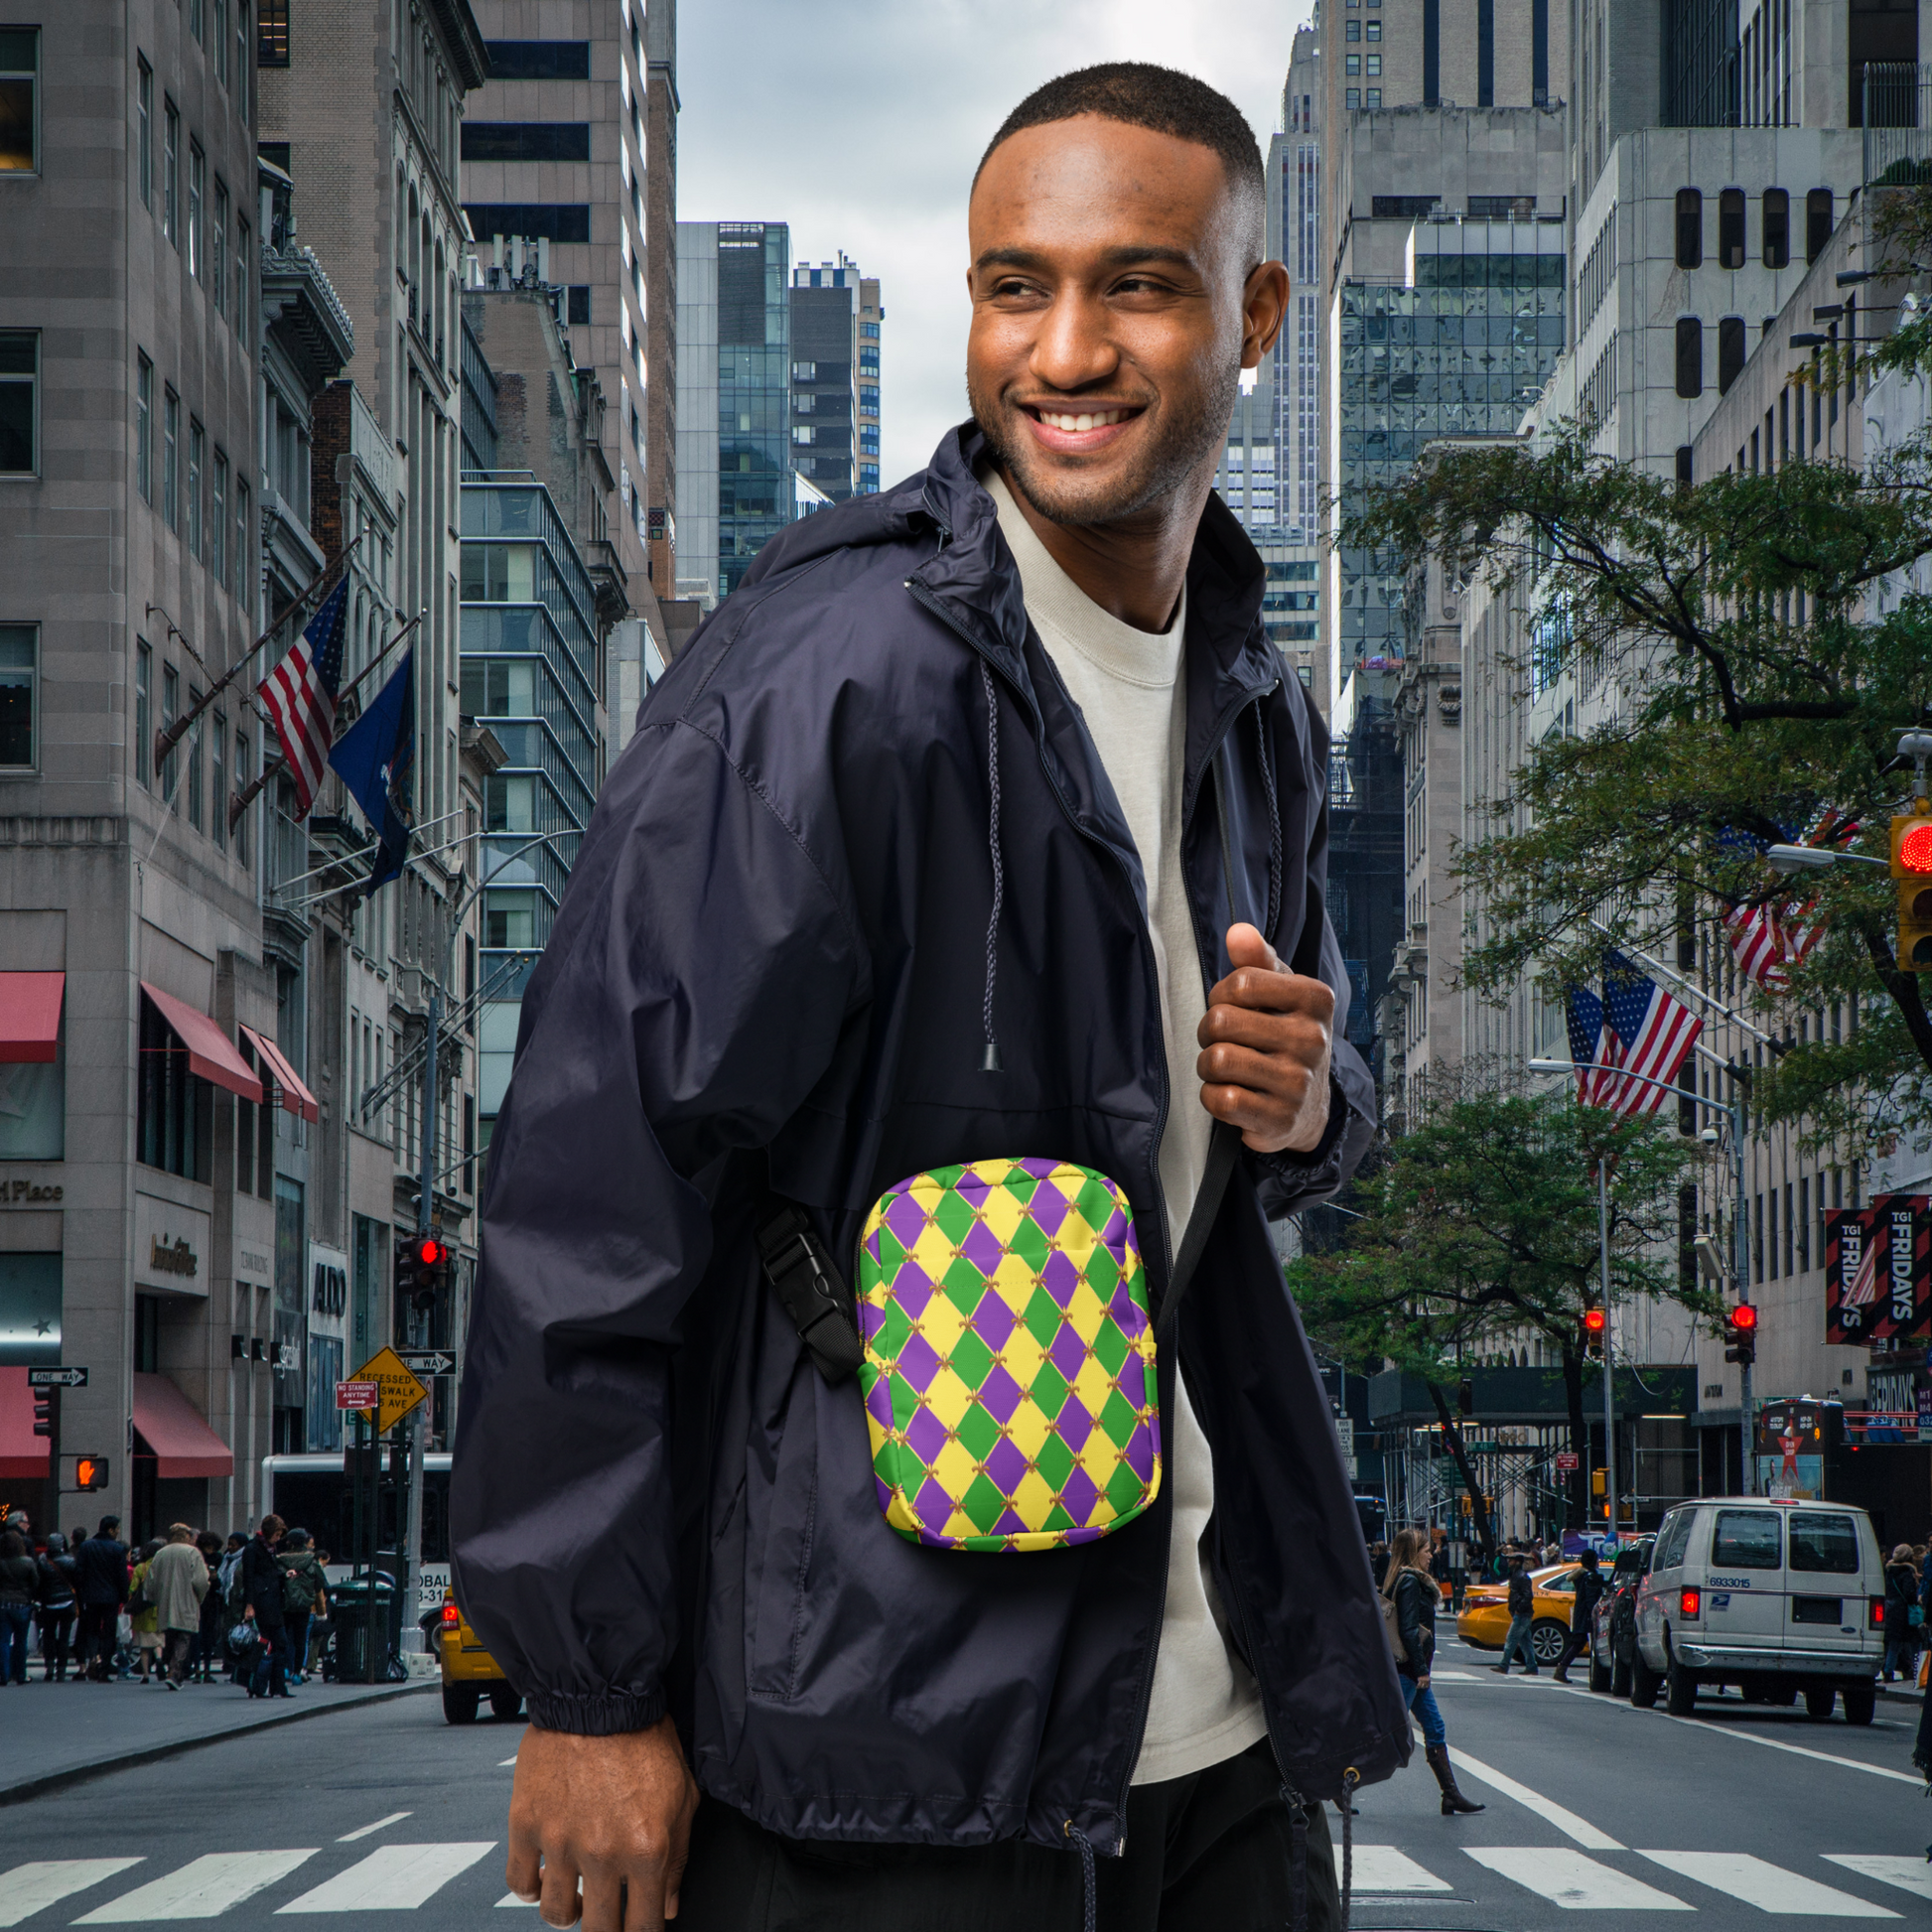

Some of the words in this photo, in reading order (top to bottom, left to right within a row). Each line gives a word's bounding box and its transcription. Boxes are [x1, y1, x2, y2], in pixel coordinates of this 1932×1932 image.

[12, 1179, 64, 1201] Place
[1891, 1211, 1912, 1222] TGI
[1842, 1225, 1862, 1235] TGI
[1891, 1224, 1913, 1320] FRIDAYS
[1842, 1237, 1862, 1327] FRIDYS
[313, 1262, 346, 1317] ALDO
[423, 1358, 445, 1368] WAY
[36, 1373, 54, 1382] ONE
[359, 1372, 411, 1384] RECESSED
[381, 1386, 415, 1397] SWALK
[1919, 1390, 1931, 1400] M1
[388, 1400, 407, 1409] AVE
[1919, 1403, 1931, 1412] M4
[1710, 1577, 1750, 1588] 6933015
